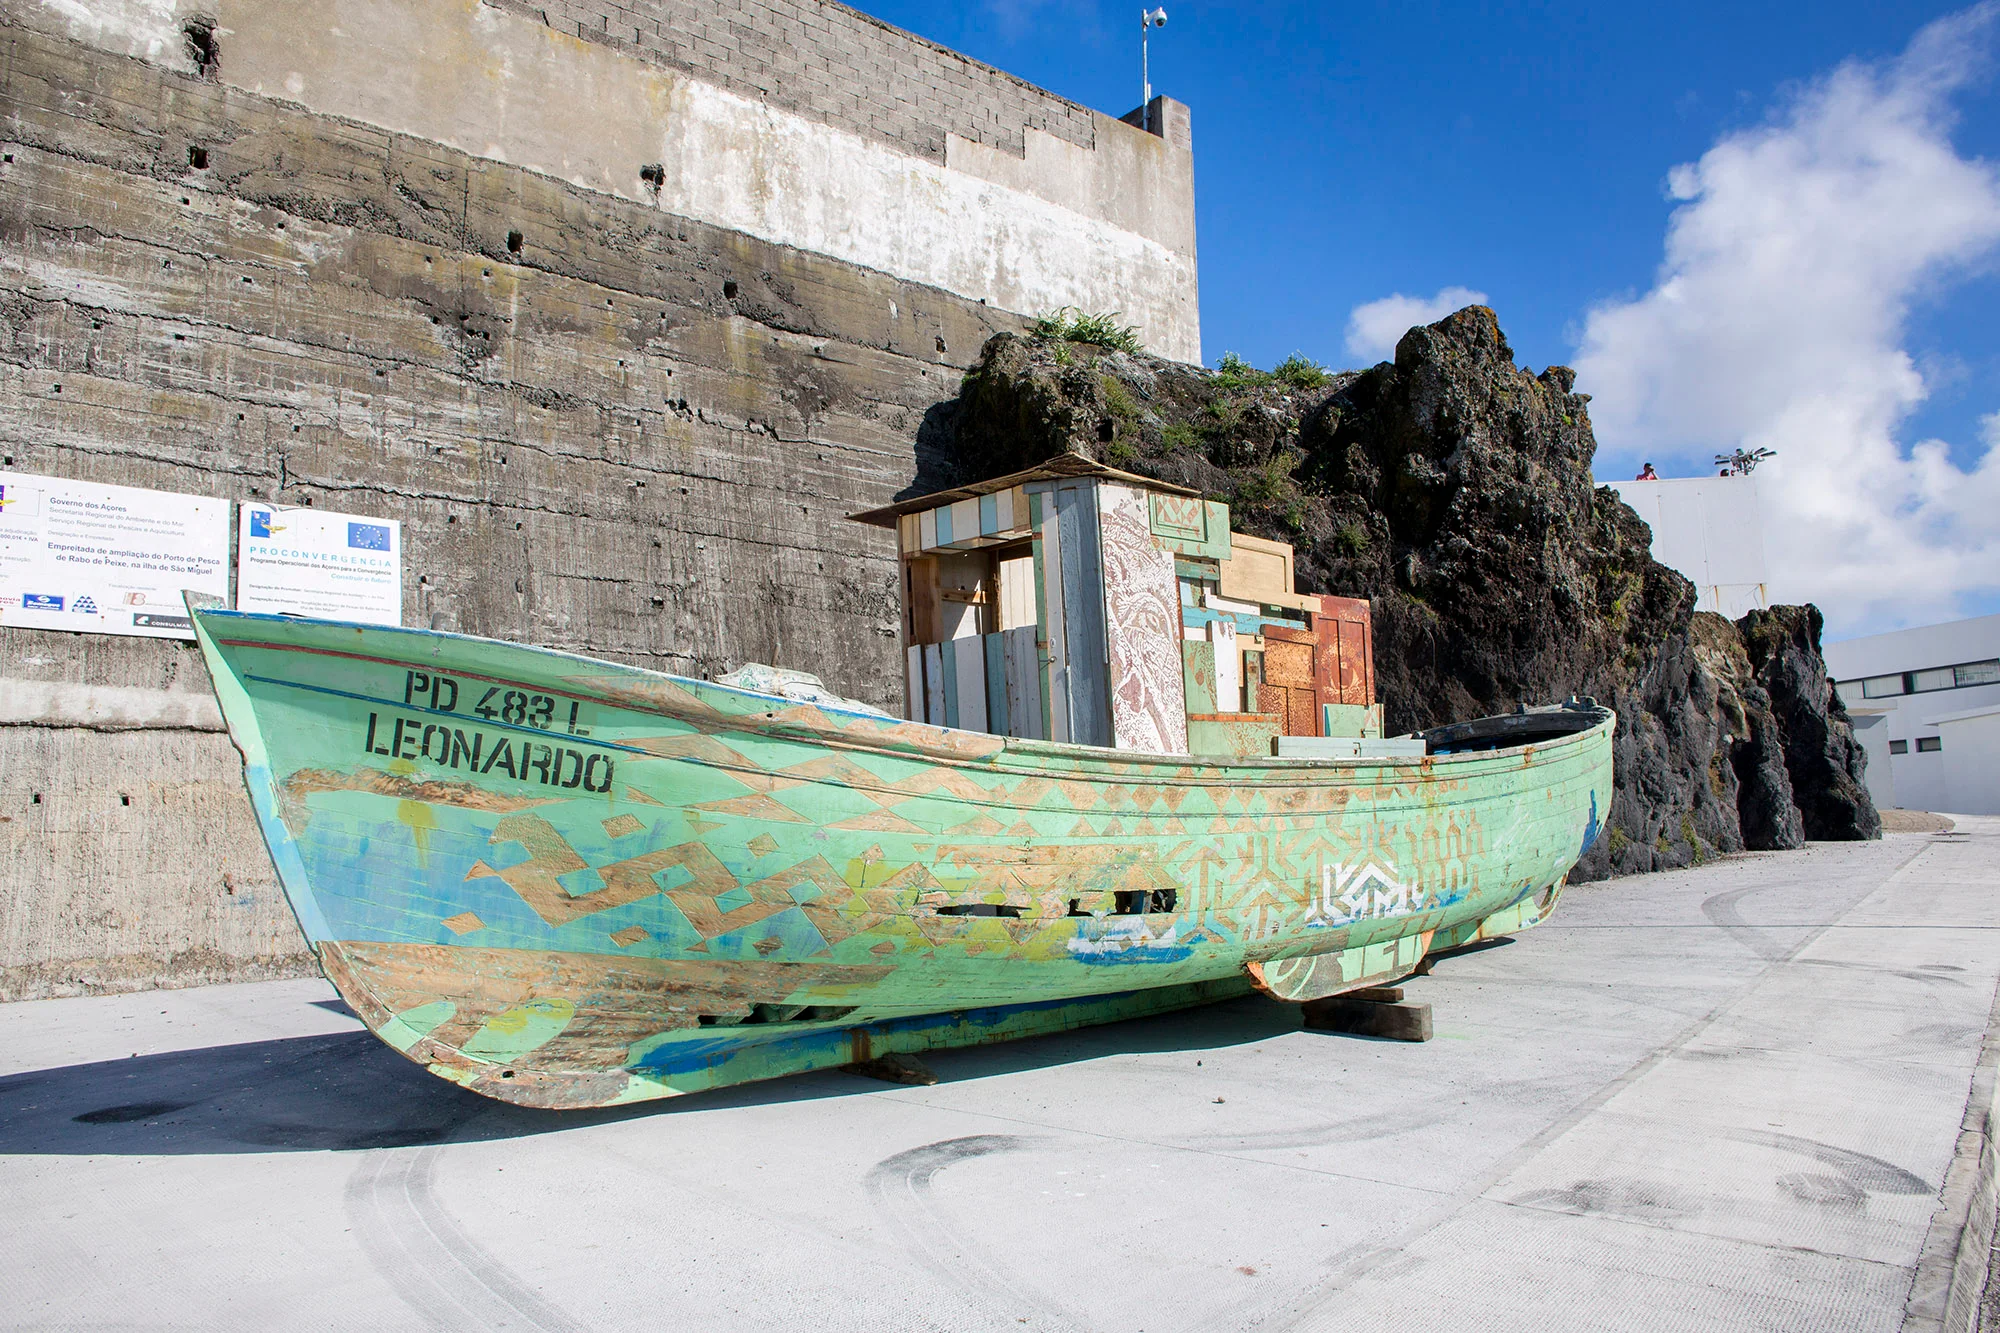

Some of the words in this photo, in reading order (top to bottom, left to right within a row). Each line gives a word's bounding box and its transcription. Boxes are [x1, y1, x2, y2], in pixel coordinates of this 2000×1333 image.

[49, 507, 83, 516] Secretaria
[85, 510, 114, 519] Regional
[50, 497, 83, 507] Governo
[101, 503, 127, 512] Açores
[48, 516, 75, 525] Serviço
[76, 520, 107, 528] Regional
[48, 542, 95, 553] Empreitada
[109, 549, 150, 558] ampliação
[163, 554, 184, 562] Porto
[197, 557, 220, 565] Pesca
[249, 546, 392, 567] PROCONVERGENCIA
[69, 555, 90, 563] Rabo
[105, 558, 129, 568] Peixe,
[143, 562, 157, 570] ilha
[187, 566, 212, 575] Miguel
[250, 557, 277, 565] Programa
[278, 559, 309, 567] Operacional
[357, 567, 392, 576] Convergência
[331, 573, 364, 582] Construir
[371, 576, 392, 584] futuro
[404, 670, 459, 712] PD
[474, 687, 556, 729] 483
[568, 701, 591, 736] L
[365, 712, 616, 793] LEONARDO
